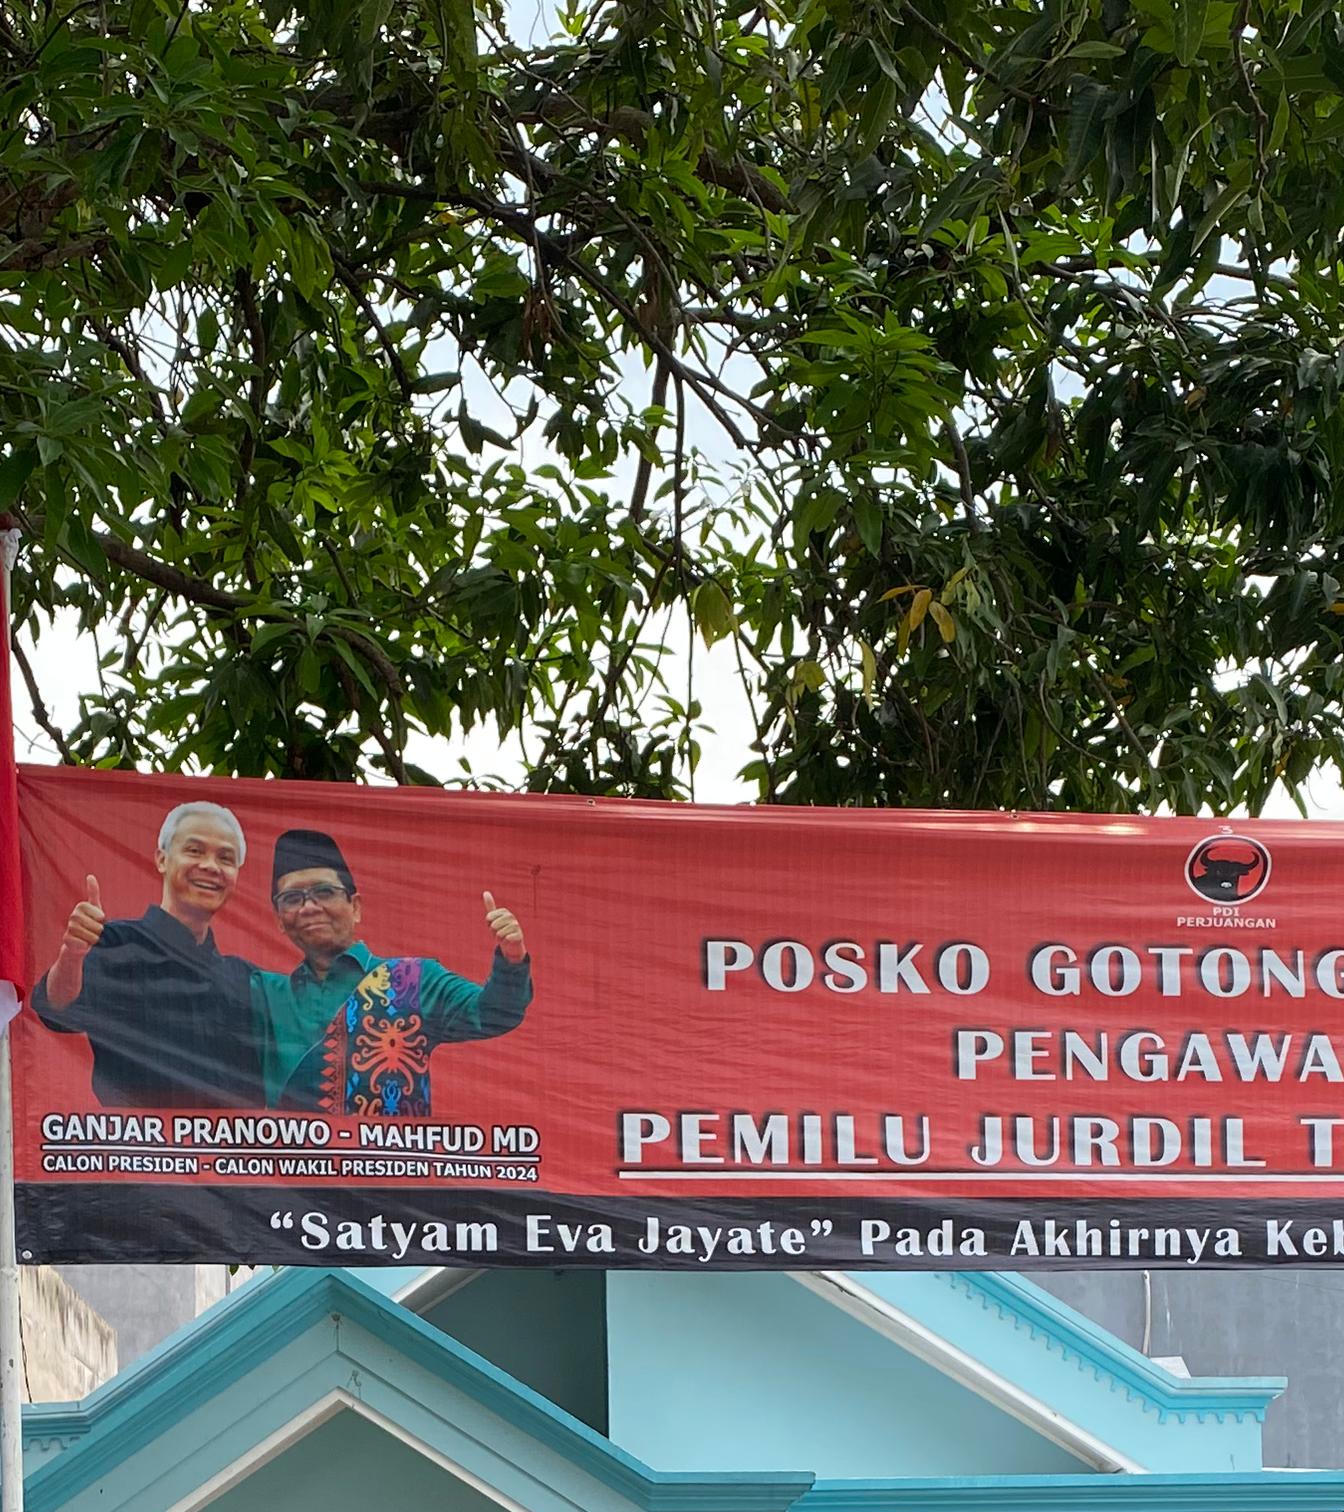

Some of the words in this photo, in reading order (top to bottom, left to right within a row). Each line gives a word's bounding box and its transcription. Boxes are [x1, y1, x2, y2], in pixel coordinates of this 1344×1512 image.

[1218, 825, 1234, 834] 3
[1176, 916, 1276, 928] PERJUANGAN
[1212, 907, 1240, 917] PDI
[706, 940, 991, 996] POSKO
[42, 1115, 165, 1143] GANJAR
[174, 1117, 330, 1146] PRANOWO
[360, 1124, 485, 1152] MAHFUD
[493, 1127, 539, 1153] MD
[621, 1112, 931, 1165] PEMILU
[971, 1116, 1266, 1167] JURDIL
[43, 1155, 103, 1172] CALON
[109, 1156, 198, 1173] PRESIDEN
[215, 1158, 274, 1175] CALON
[279, 1158, 337, 1176] WAKIL
[342, 1160, 430, 1178] PRESIDEN
[433, 1162, 491, 1179] TAHUN
[497, 1165, 538, 1181] 2024
[525, 1213, 615, 1253] Eva
[860, 1218, 987, 1257] Pada
[1010, 1218, 1243, 1265] Akhirnya
